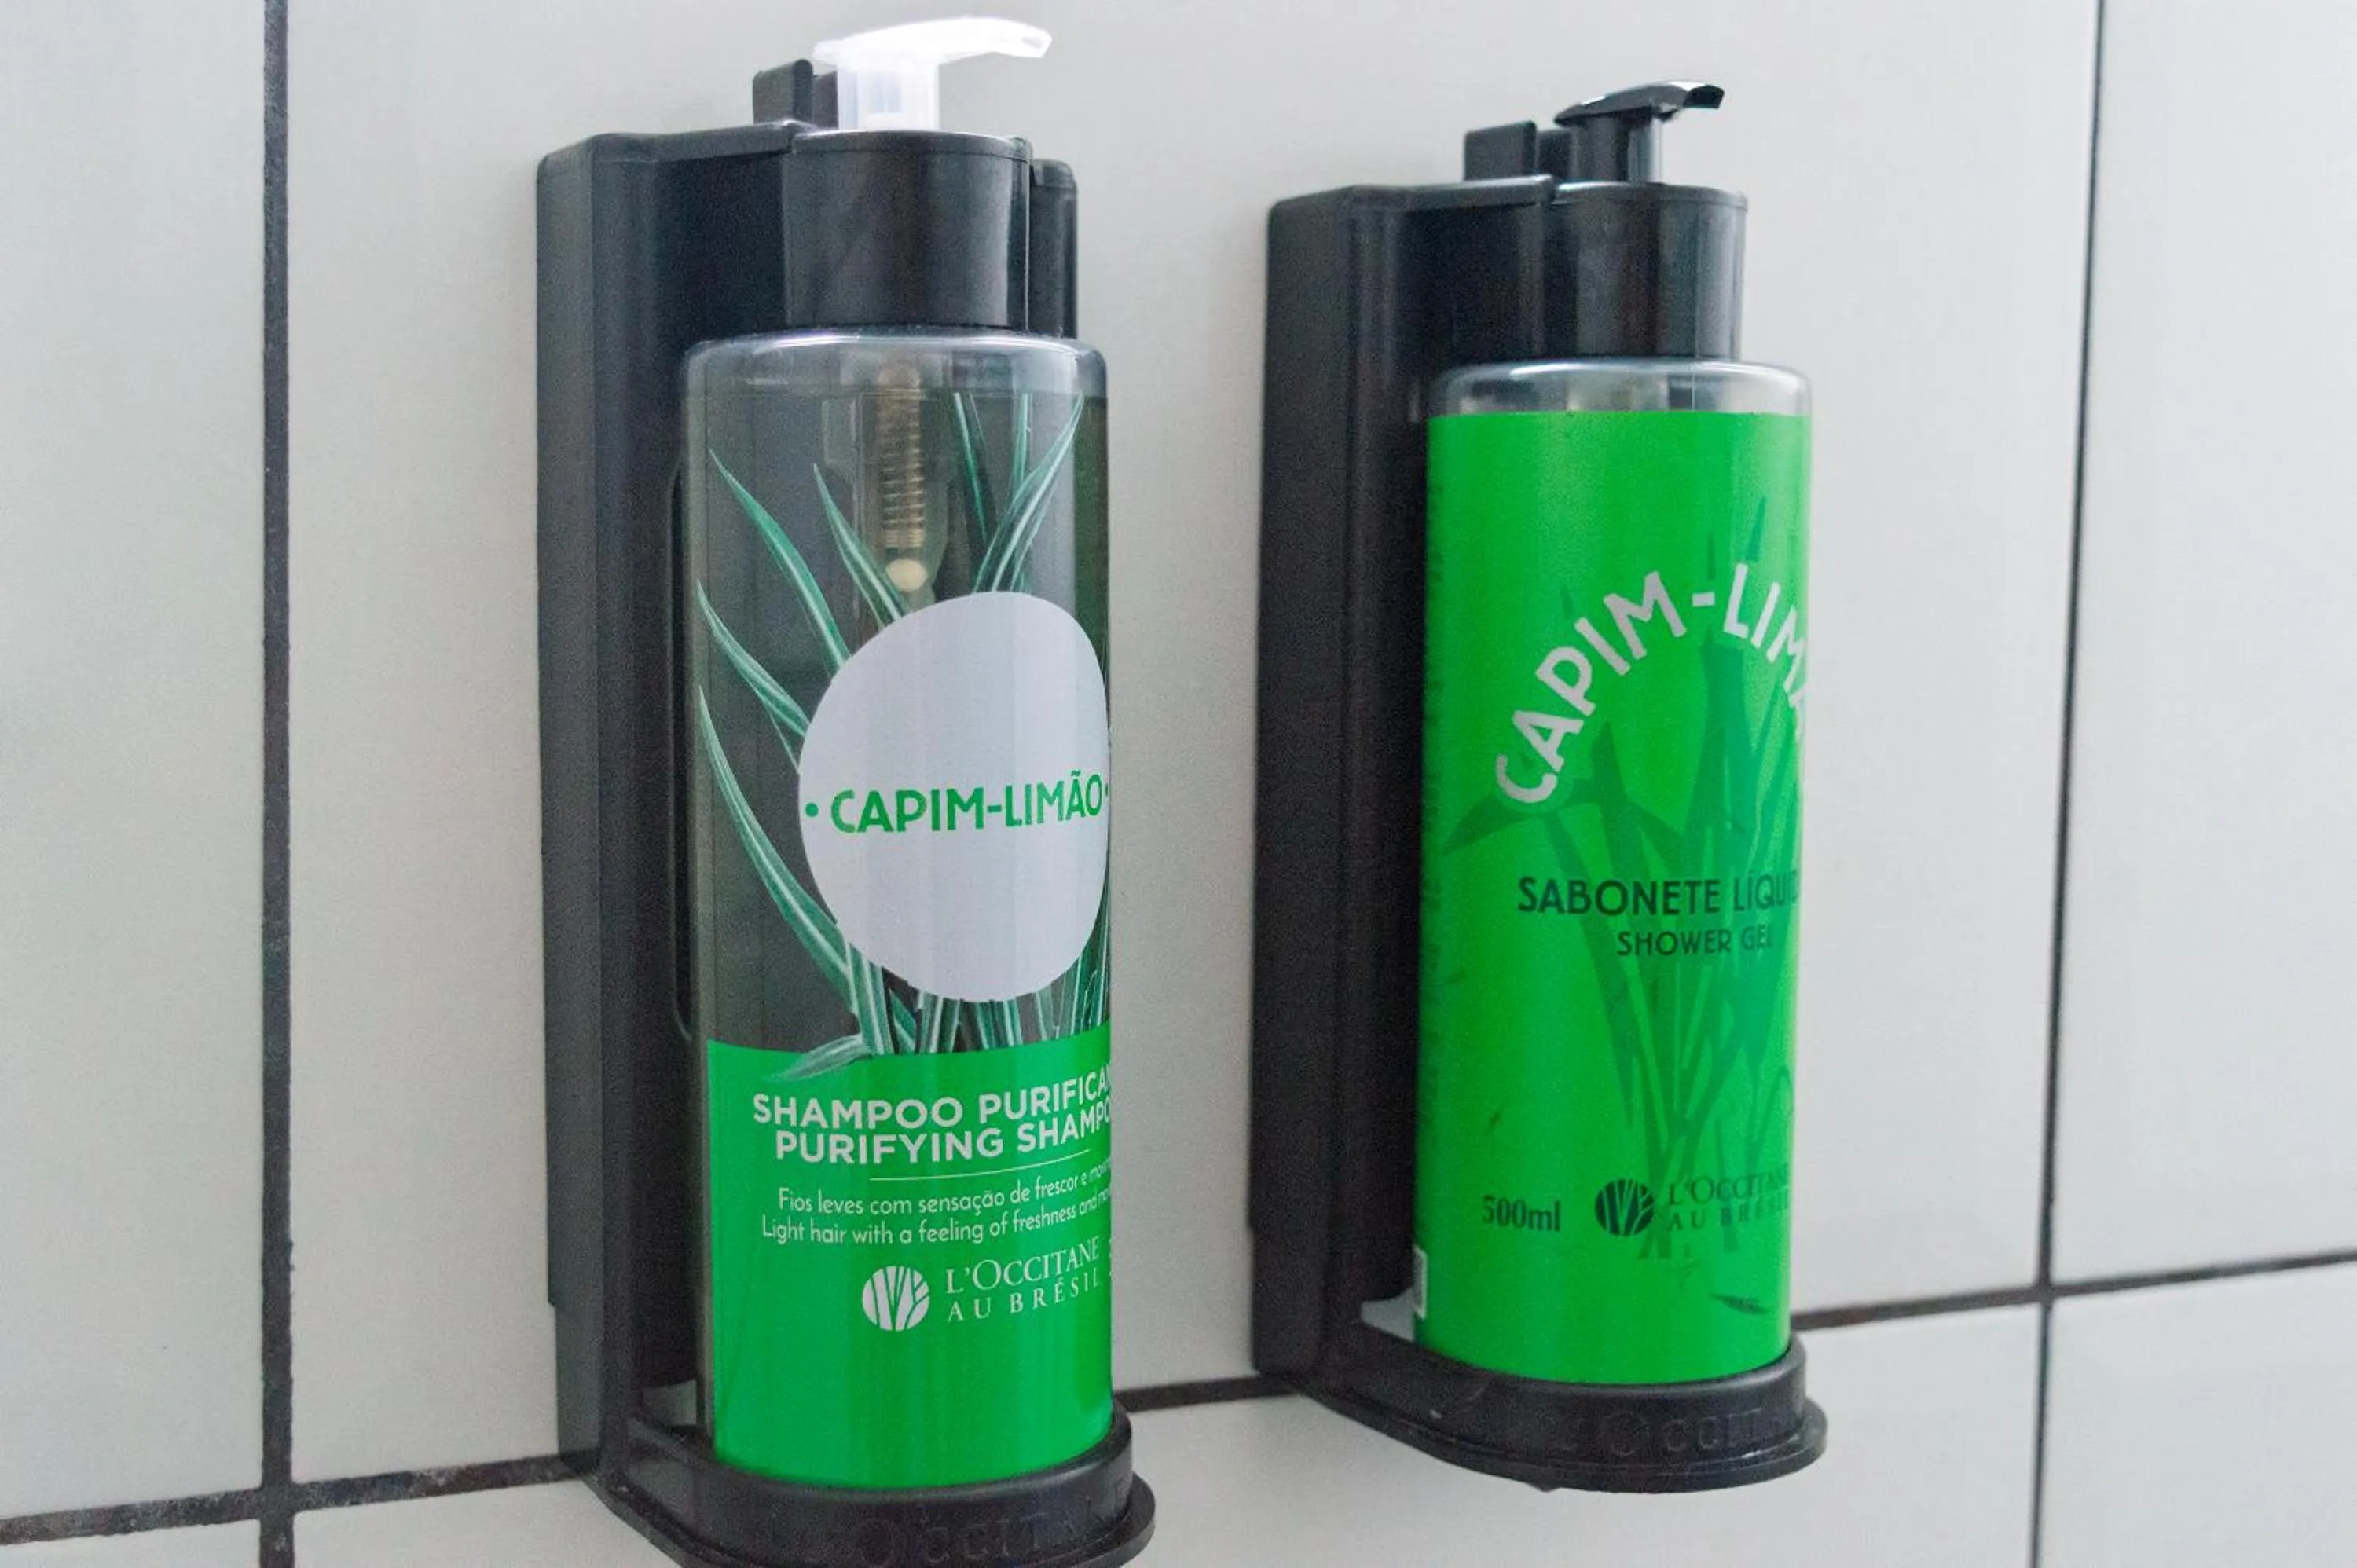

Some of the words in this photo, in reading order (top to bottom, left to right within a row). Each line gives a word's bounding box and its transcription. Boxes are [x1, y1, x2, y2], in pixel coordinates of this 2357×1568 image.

[830, 770, 1102, 833] CAPIM-LIMÃO
[1518, 877, 1721, 914] SABONETE
[1617, 929, 1732, 956] SHOWER
[1740, 924, 1773, 951] GEL
[753, 1093, 963, 1130] SHAMPOO
[775, 1127, 1004, 1163] PURIFYING
[779, 1187, 812, 1212] Fios
[818, 1189, 864, 1214] leves
[870, 1198, 912, 1214] com
[918, 1189, 1005, 1216] sensação
[1010, 1178, 1031, 1203] de
[1035, 1175, 1079, 1199] frescor
[1080, 1172, 1087, 1185] e
[762, 1214, 805, 1244] Light
[810, 1218, 846, 1244] hair
[852, 1220, 893, 1244] with
[899, 1228, 913, 1244] a
[918, 1217, 984, 1244] feeling
[989, 1211, 1008, 1236] of
[1013, 1203, 1076, 1232] freshness
[1483, 1195, 1561, 1231] 500ml
[1667, 1208, 1706, 1231] AU
[946, 1236, 1099, 1294] L'OCCITANE
[948, 1296, 992, 1322] AU
[1010, 1267, 1100, 1313] BRÉSIL
